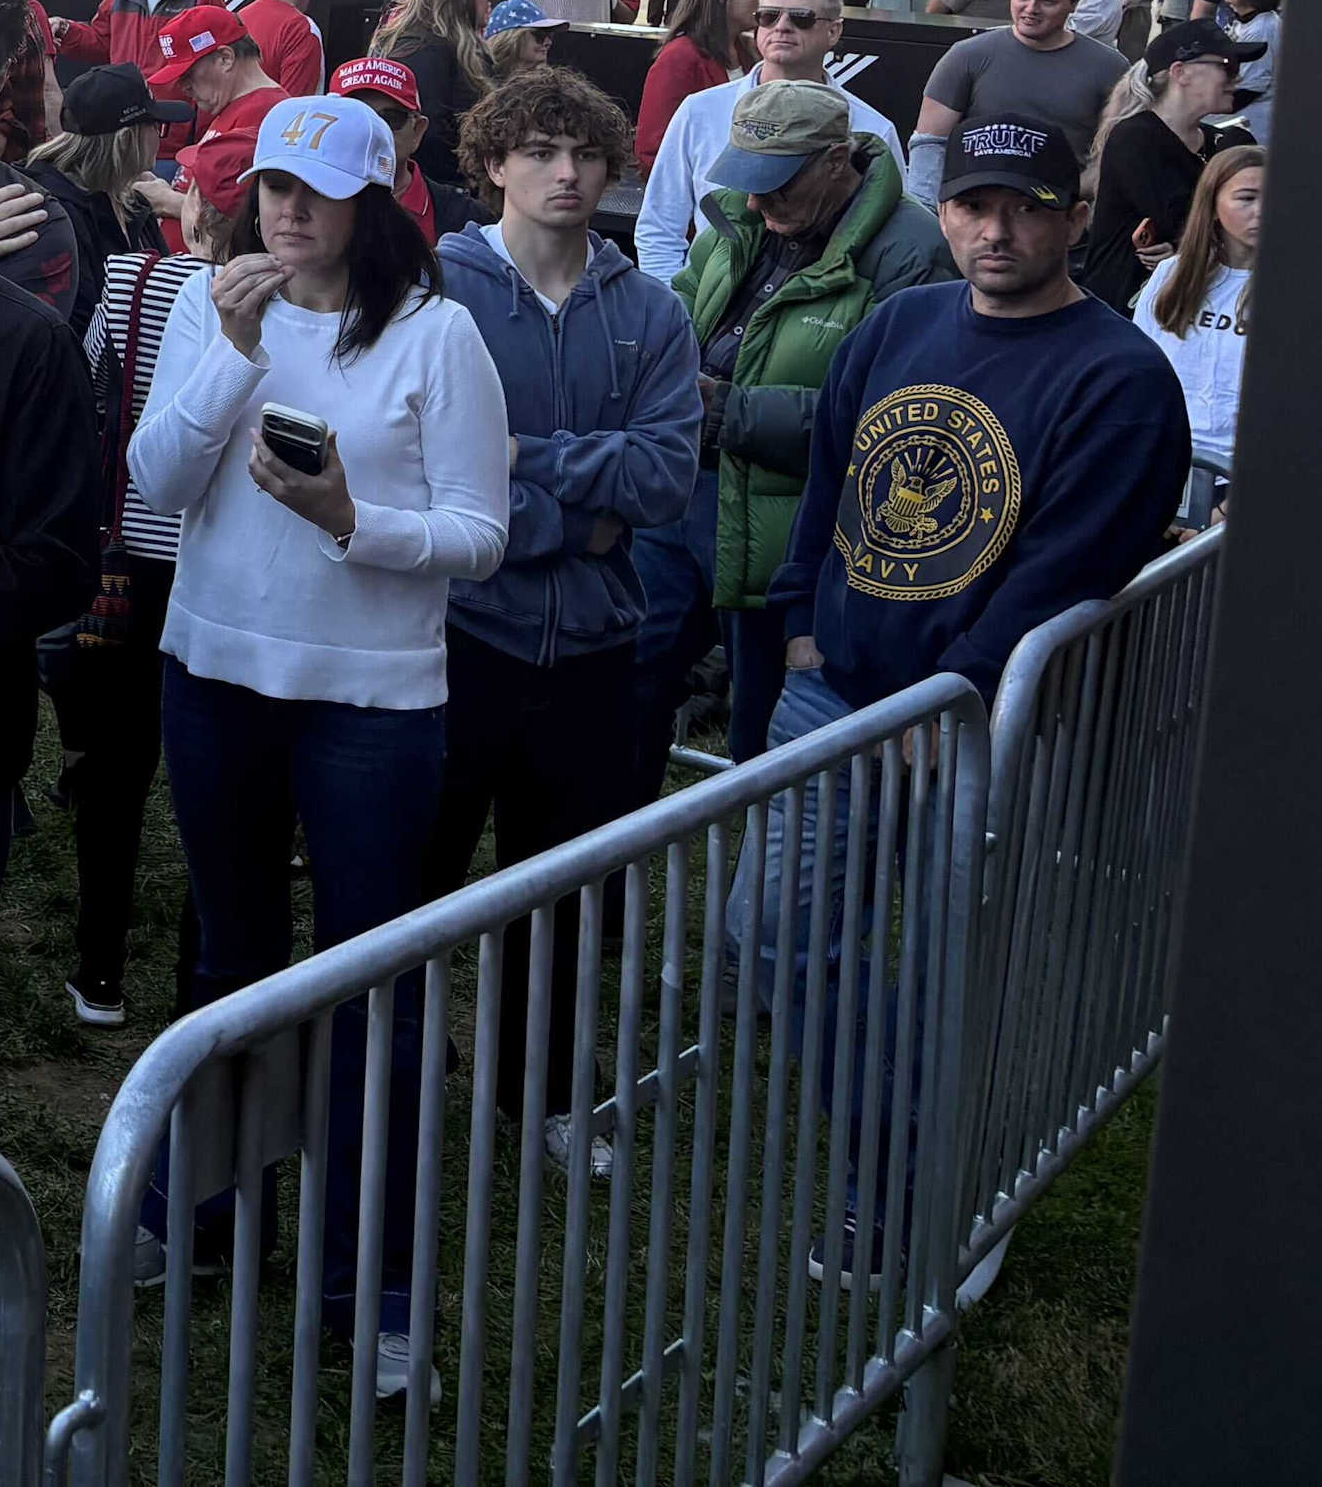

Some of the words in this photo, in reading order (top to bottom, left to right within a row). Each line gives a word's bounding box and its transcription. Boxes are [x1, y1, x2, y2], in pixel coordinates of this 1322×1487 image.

[339, 61, 365, 78] MAKE
[365, 60, 407, 81] AMERICA
[341, 73, 373, 89] GREAT
[373, 74, 403, 90] AGAIN
[280, 111, 339, 150] 47
[962, 130, 1046, 153] TRUMP
[857, 402, 939, 452] UNITED
[947, 410, 1000, 495] STATES
